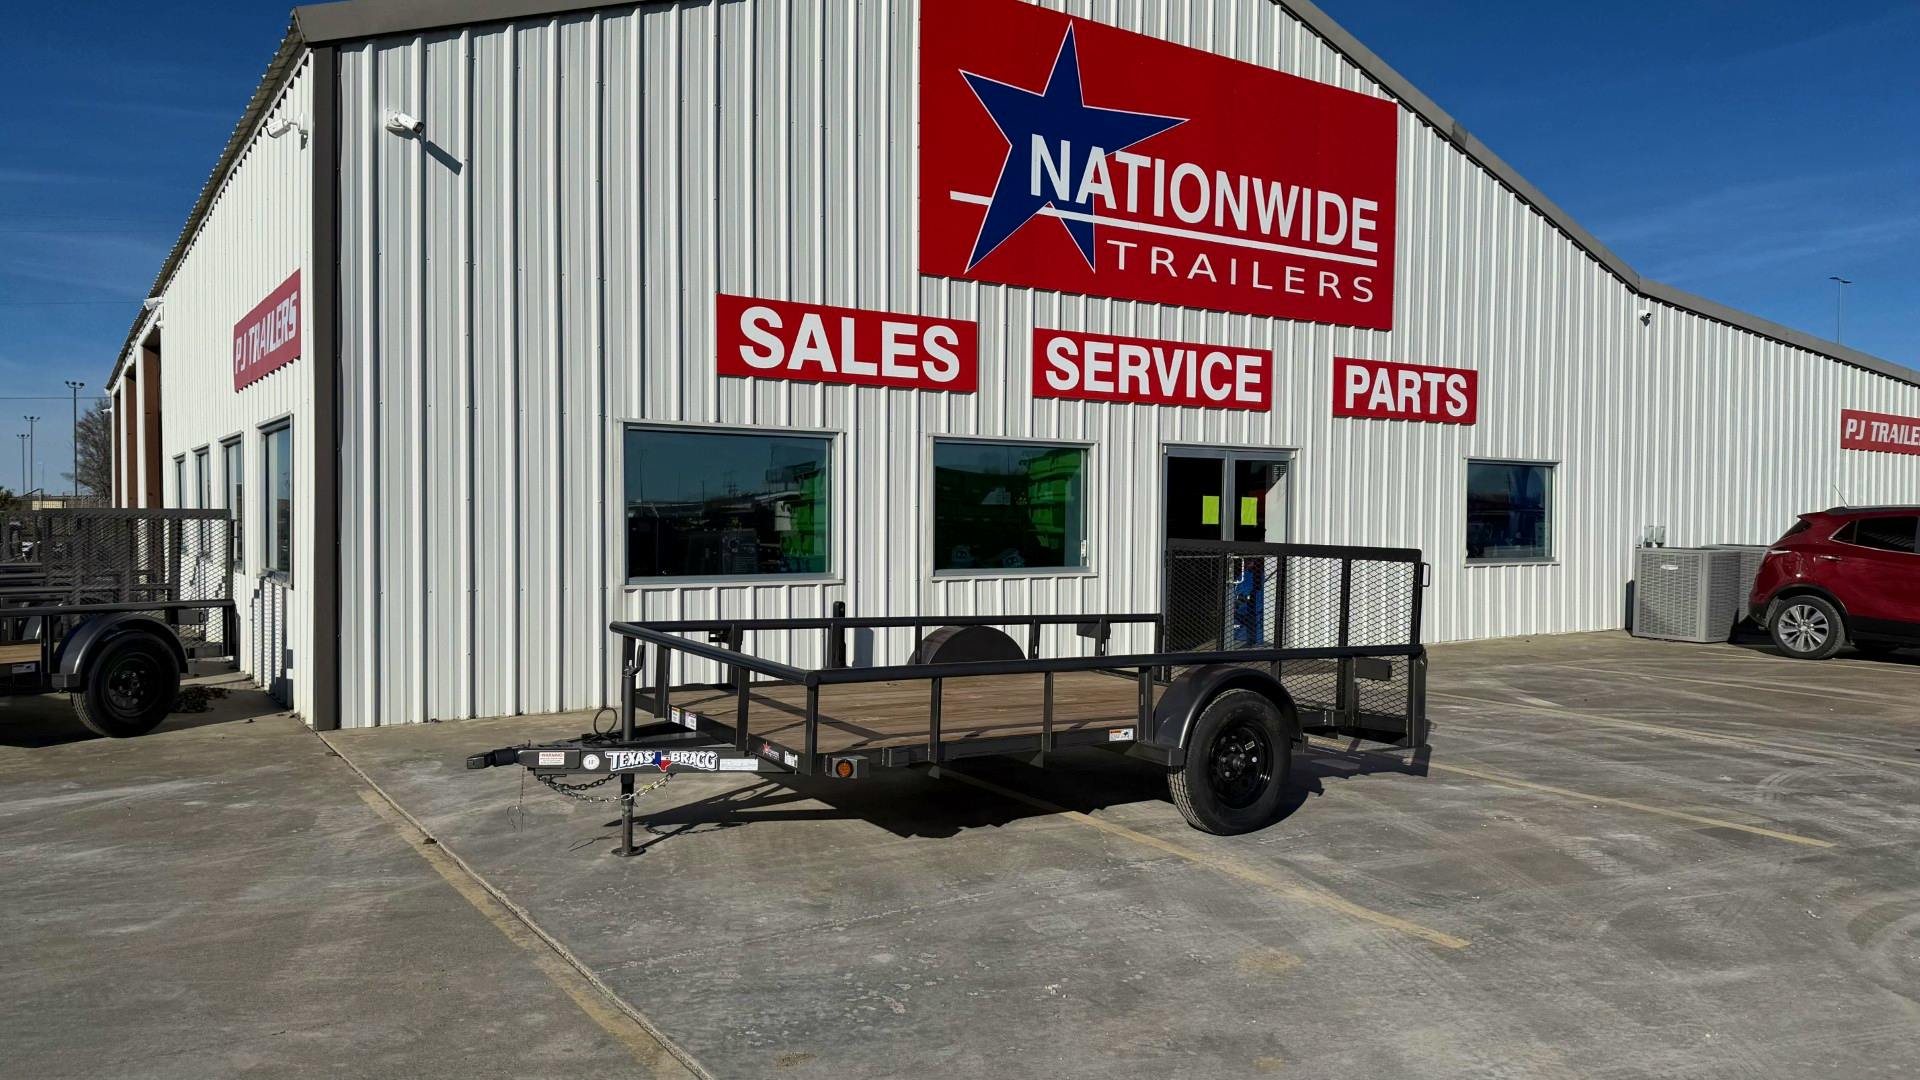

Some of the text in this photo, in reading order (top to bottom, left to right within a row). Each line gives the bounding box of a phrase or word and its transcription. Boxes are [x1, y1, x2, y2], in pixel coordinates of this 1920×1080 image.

[1030, 133, 1378, 253] NATIONWIDE
[1106, 239, 1374, 303] TRAILERS
[235, 290, 298, 374] PJ TRAILERS
[739, 306, 960, 383] SALES
[1045, 336, 1262, 403] SERVICE
[1345, 364, 1468, 417] PARTS
[1845, 418, 1920, 446] PJ TRAILE
[604, 750, 655, 771] TEXAS
[669, 751, 718, 771] BRAGG
